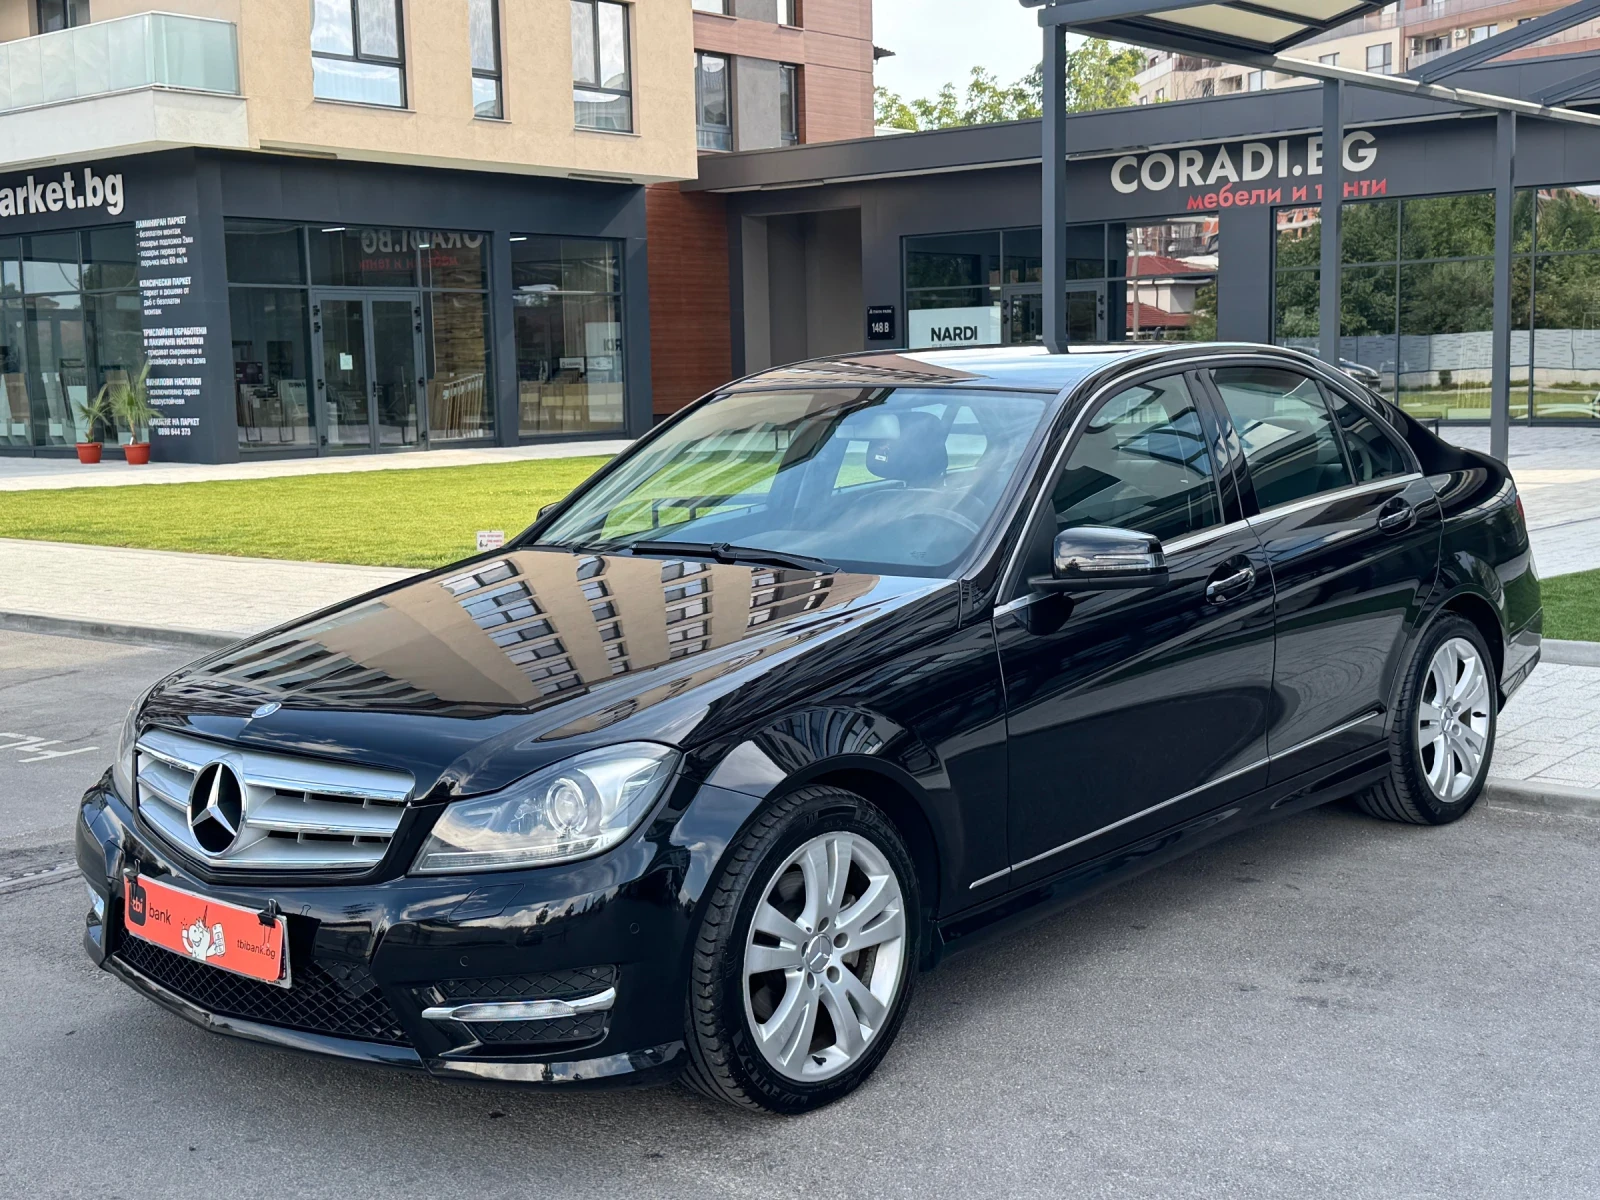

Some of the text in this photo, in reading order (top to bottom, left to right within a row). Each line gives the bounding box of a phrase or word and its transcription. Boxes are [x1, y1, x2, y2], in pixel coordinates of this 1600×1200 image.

[1186, 178, 1387, 211] мебели и тнти
[136, 216, 186, 229] ЛАМИНИРАН ПАРКЕТ
[182, 236, 193, 244] 2мм
[177, 247, 186, 255] при
[169, 256, 175, 264] 60
[140, 276, 191, 287] КЛАСИЧЕСКИ ПАРКЕТ
[157, 298, 180, 306] безплатен
[143, 327, 207, 337] ТРИСЛОЙНИ ОБРАБОТЕНИ
[872, 322, 883, 333] 148
[931, 326, 977, 342] NARDI
[144, 336, 204, 346] И ЛАКИРАНИ НАСТИЛКИ
[178, 358, 186, 366] дух
[146, 377, 201, 386] ВИНИЛОВИ НАСТИЛКИ
[172, 418, 179, 426] НА
[180, 418, 199, 426] ПАРКЕТ
[171, 428, 180, 436] 644
[149, 902, 171, 925] bank
[237, 939, 276, 960] tbibank.bg
